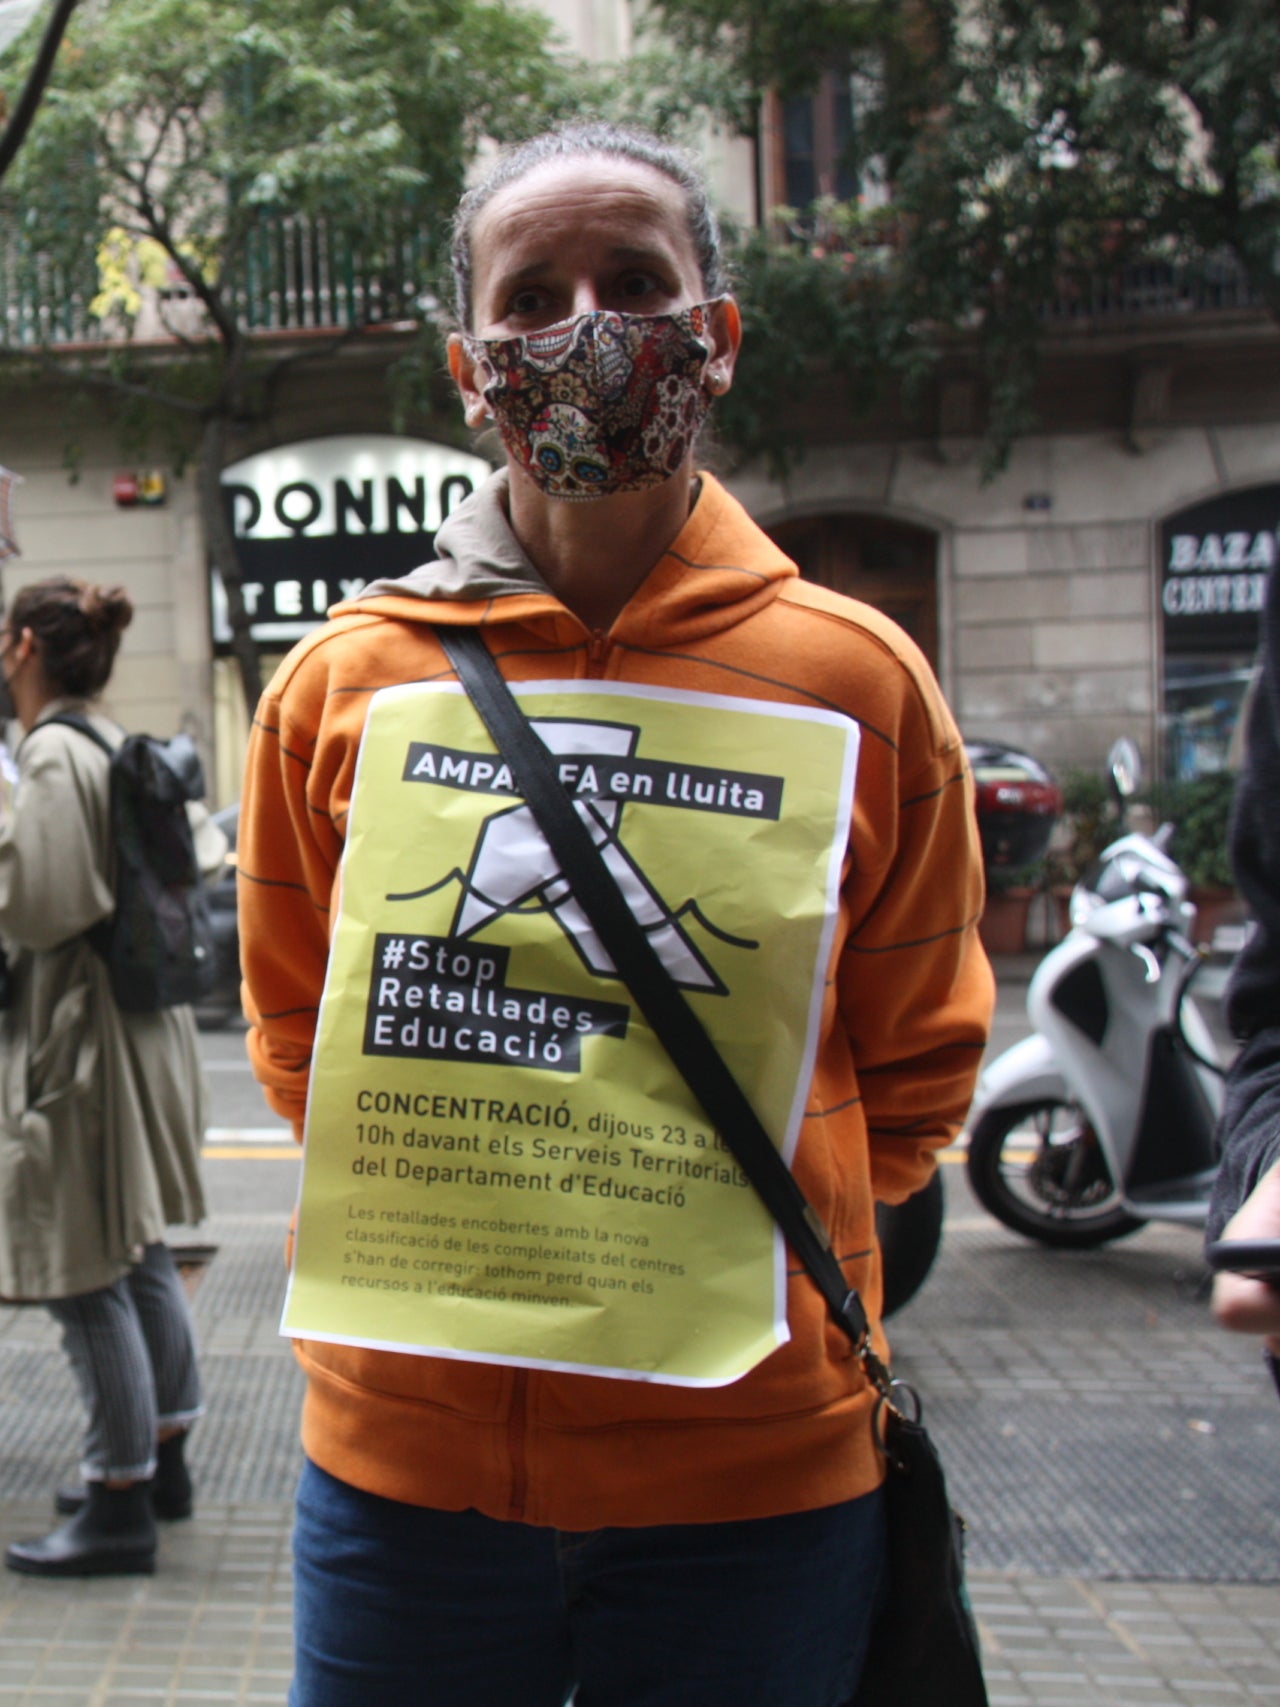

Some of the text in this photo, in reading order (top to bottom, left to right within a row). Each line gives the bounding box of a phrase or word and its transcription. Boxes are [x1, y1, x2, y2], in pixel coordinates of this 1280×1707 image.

[411, 751, 764, 811] AMPAFA en lluita
[383, 939, 496, 986] #Stop
[378, 977, 593, 1033] Retallades
[374, 1014, 562, 1063] Educació
[356, 1090, 578, 1133] CONCENTRACIÓ,
[587, 1112, 654, 1140] dijous
[661, 1124, 686, 1146] 23
[694, 1134, 706, 1148] a
[356, 1123, 395, 1145] 10h
[402, 1127, 480, 1153] davant
[488, 1135, 524, 1157] els
[532, 1138, 622, 1167] Serveis
[351, 1155, 686, 1208] del Departament d'Educació
[348, 1204, 650, 1248] Les retallades encobertes amb la nova
[343, 1250, 385, 1266] s'han
[389, 1255, 408, 1269] de
[485, 1265, 542, 1280] tothom
[546, 1271, 583, 1287] perd
[587, 1276, 627, 1290] quan
[631, 1279, 654, 1295] els
[345, 1228, 686, 1276] classificació de les complexitats del centres
[340, 1274, 576, 1307] recursos a l'educació minven.
